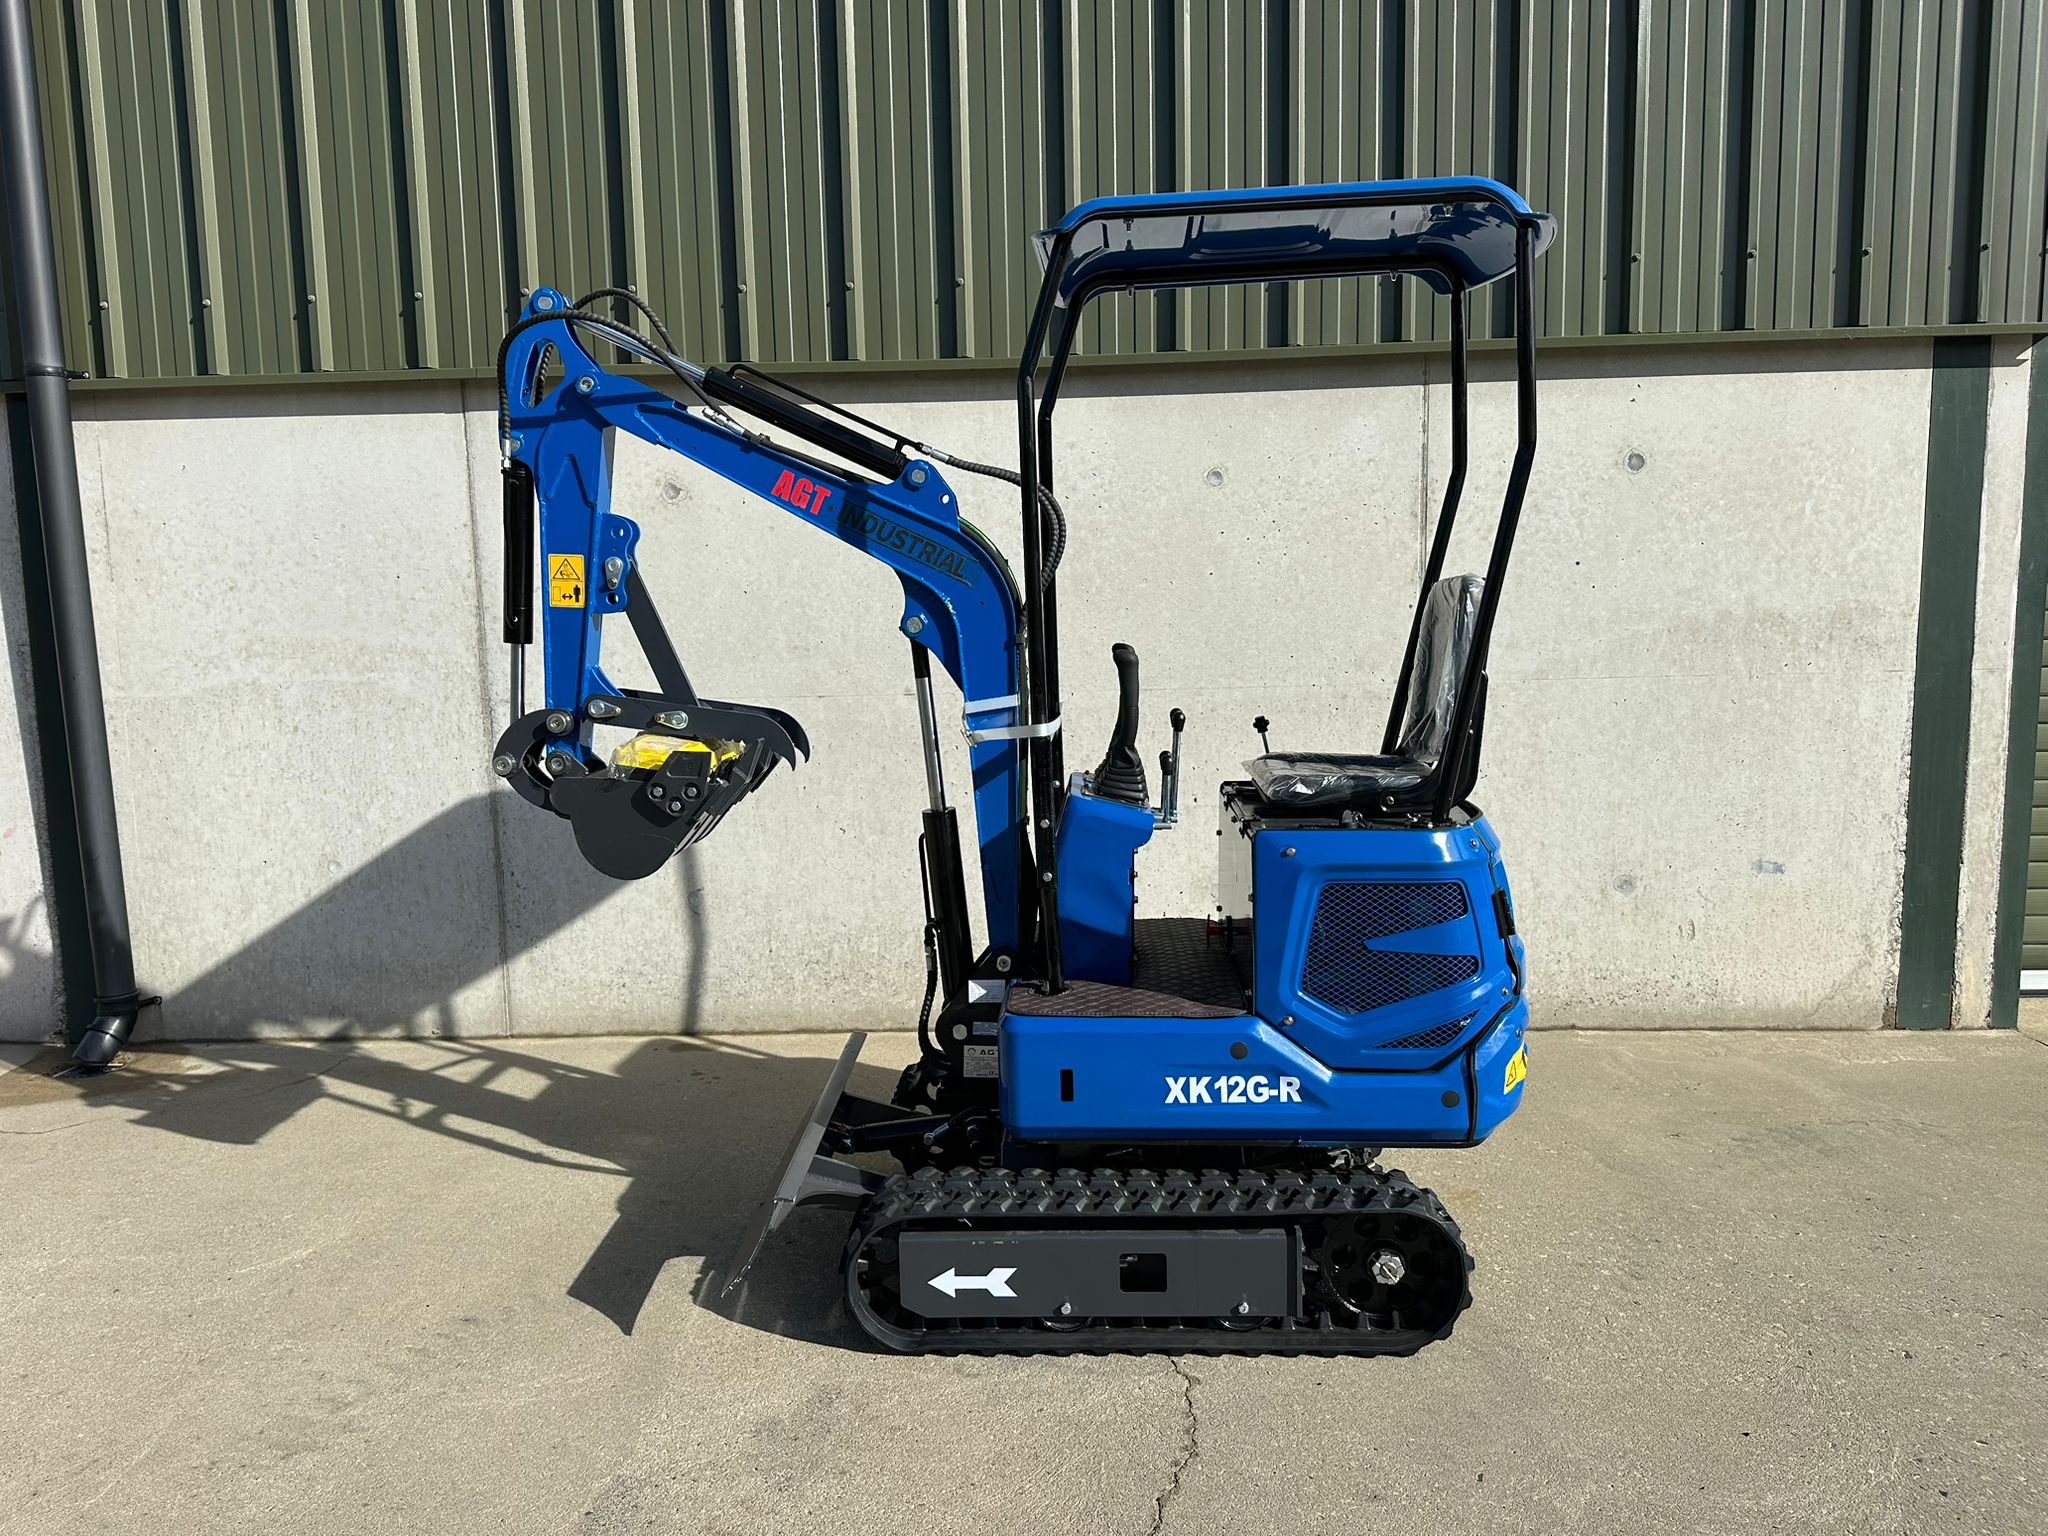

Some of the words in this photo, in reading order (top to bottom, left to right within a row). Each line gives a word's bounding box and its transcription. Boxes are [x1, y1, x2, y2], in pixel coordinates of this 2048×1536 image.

[771, 470, 831, 515] AGT
[837, 503, 966, 577] INDUSTRIAL
[1165, 1075, 1302, 1104] XK12G-R
